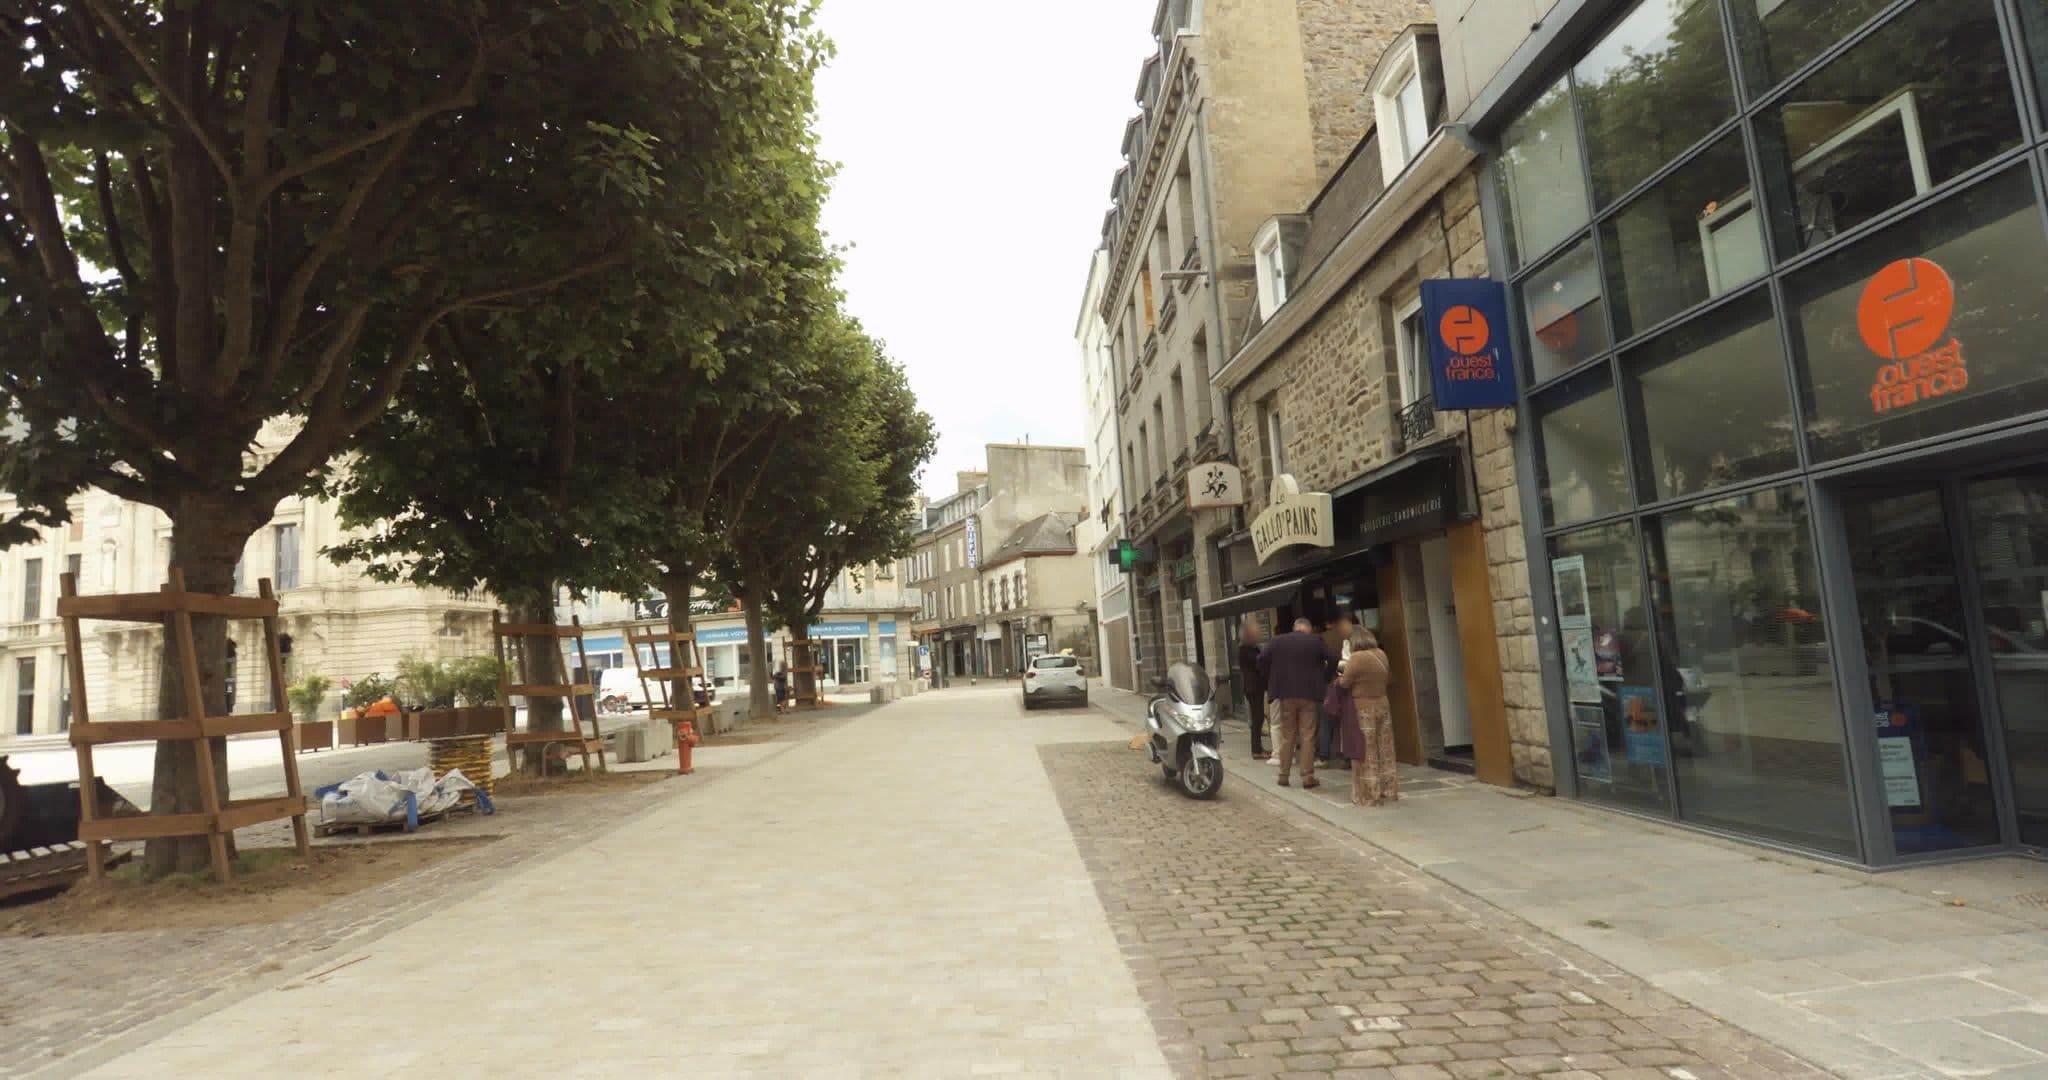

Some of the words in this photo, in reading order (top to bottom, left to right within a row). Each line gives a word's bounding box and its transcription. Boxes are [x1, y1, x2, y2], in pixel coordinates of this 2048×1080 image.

[1446, 365, 1496, 381] france
[1449, 352, 1492, 369] ouest
[1877, 337, 1966, 386] ouest
[1870, 367, 1969, 413] france
[1255, 506, 1318, 553] GALLO'PAINS
